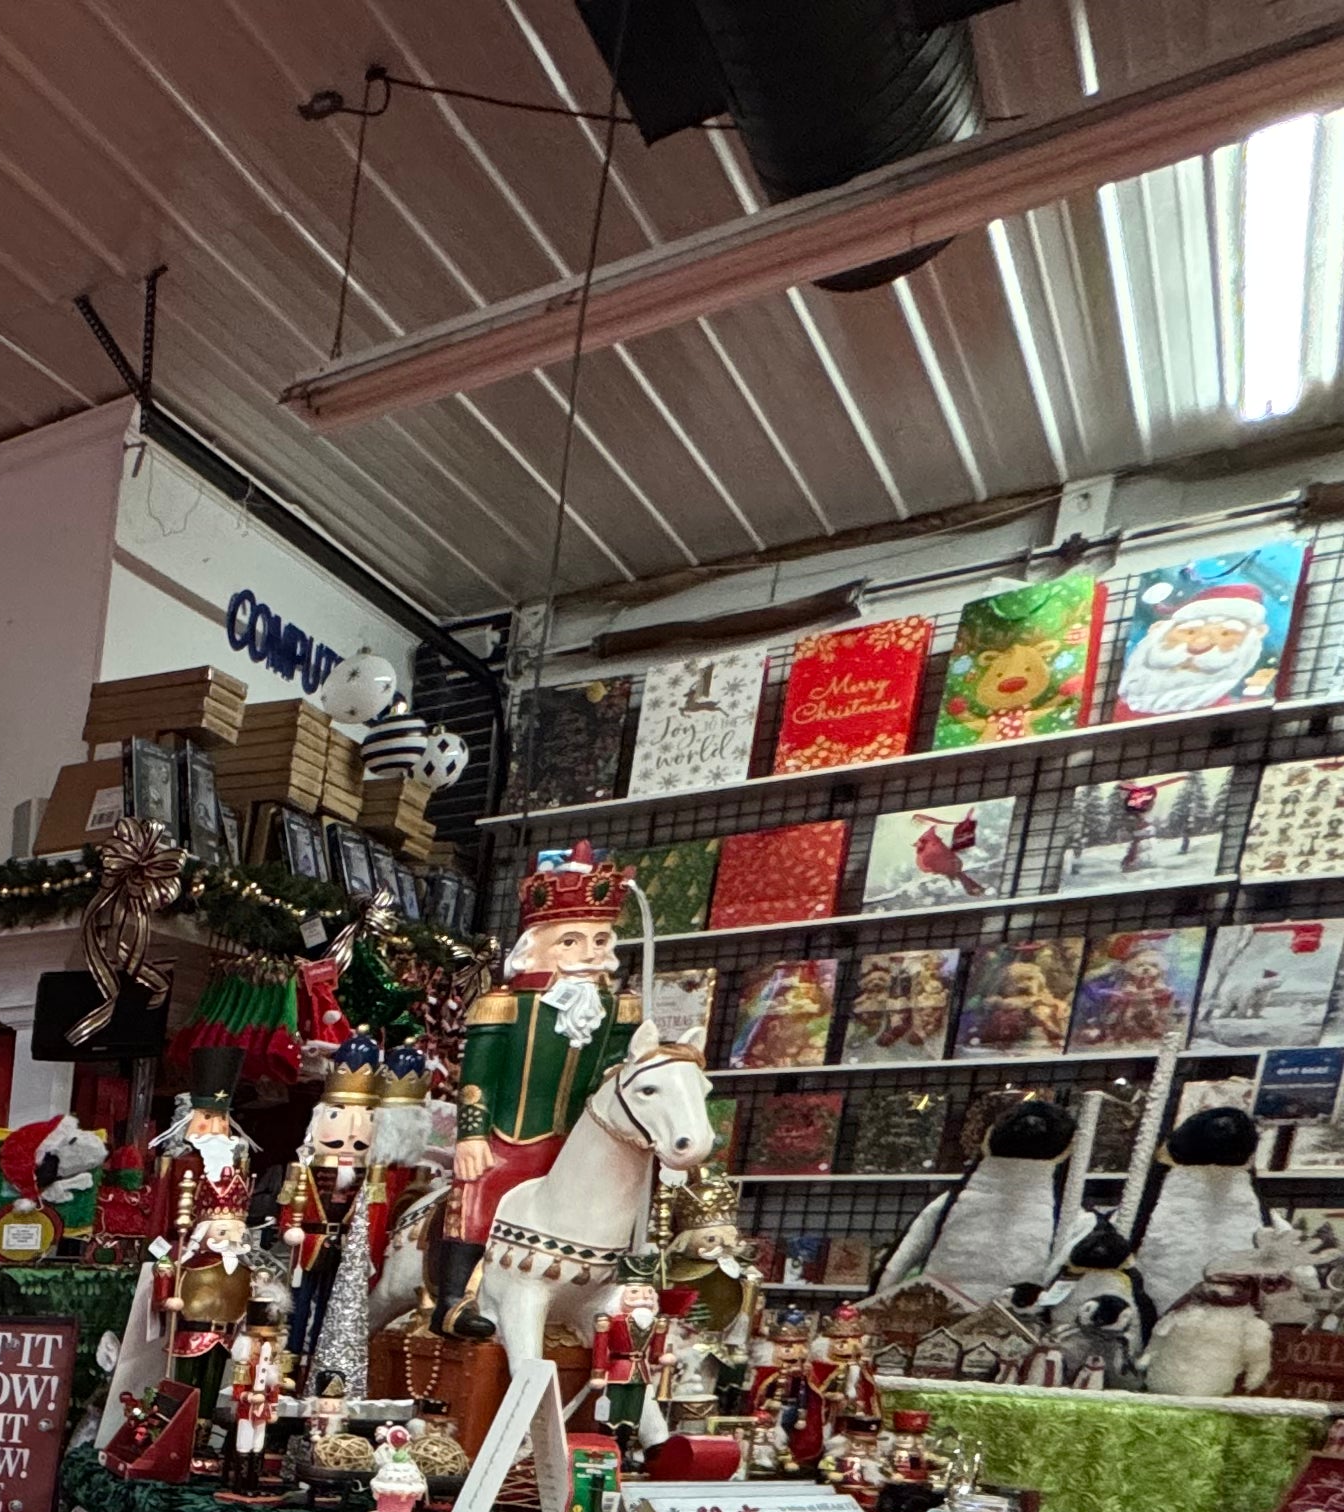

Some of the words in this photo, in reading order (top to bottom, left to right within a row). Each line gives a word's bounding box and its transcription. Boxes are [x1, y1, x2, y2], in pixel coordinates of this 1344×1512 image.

[809, 673, 890, 700] Merry
[793, 699, 901, 724] Christmas
[651, 716, 696, 747] Joy
[657, 730, 735, 770] world
[16, 1332, 62, 1368] IT
